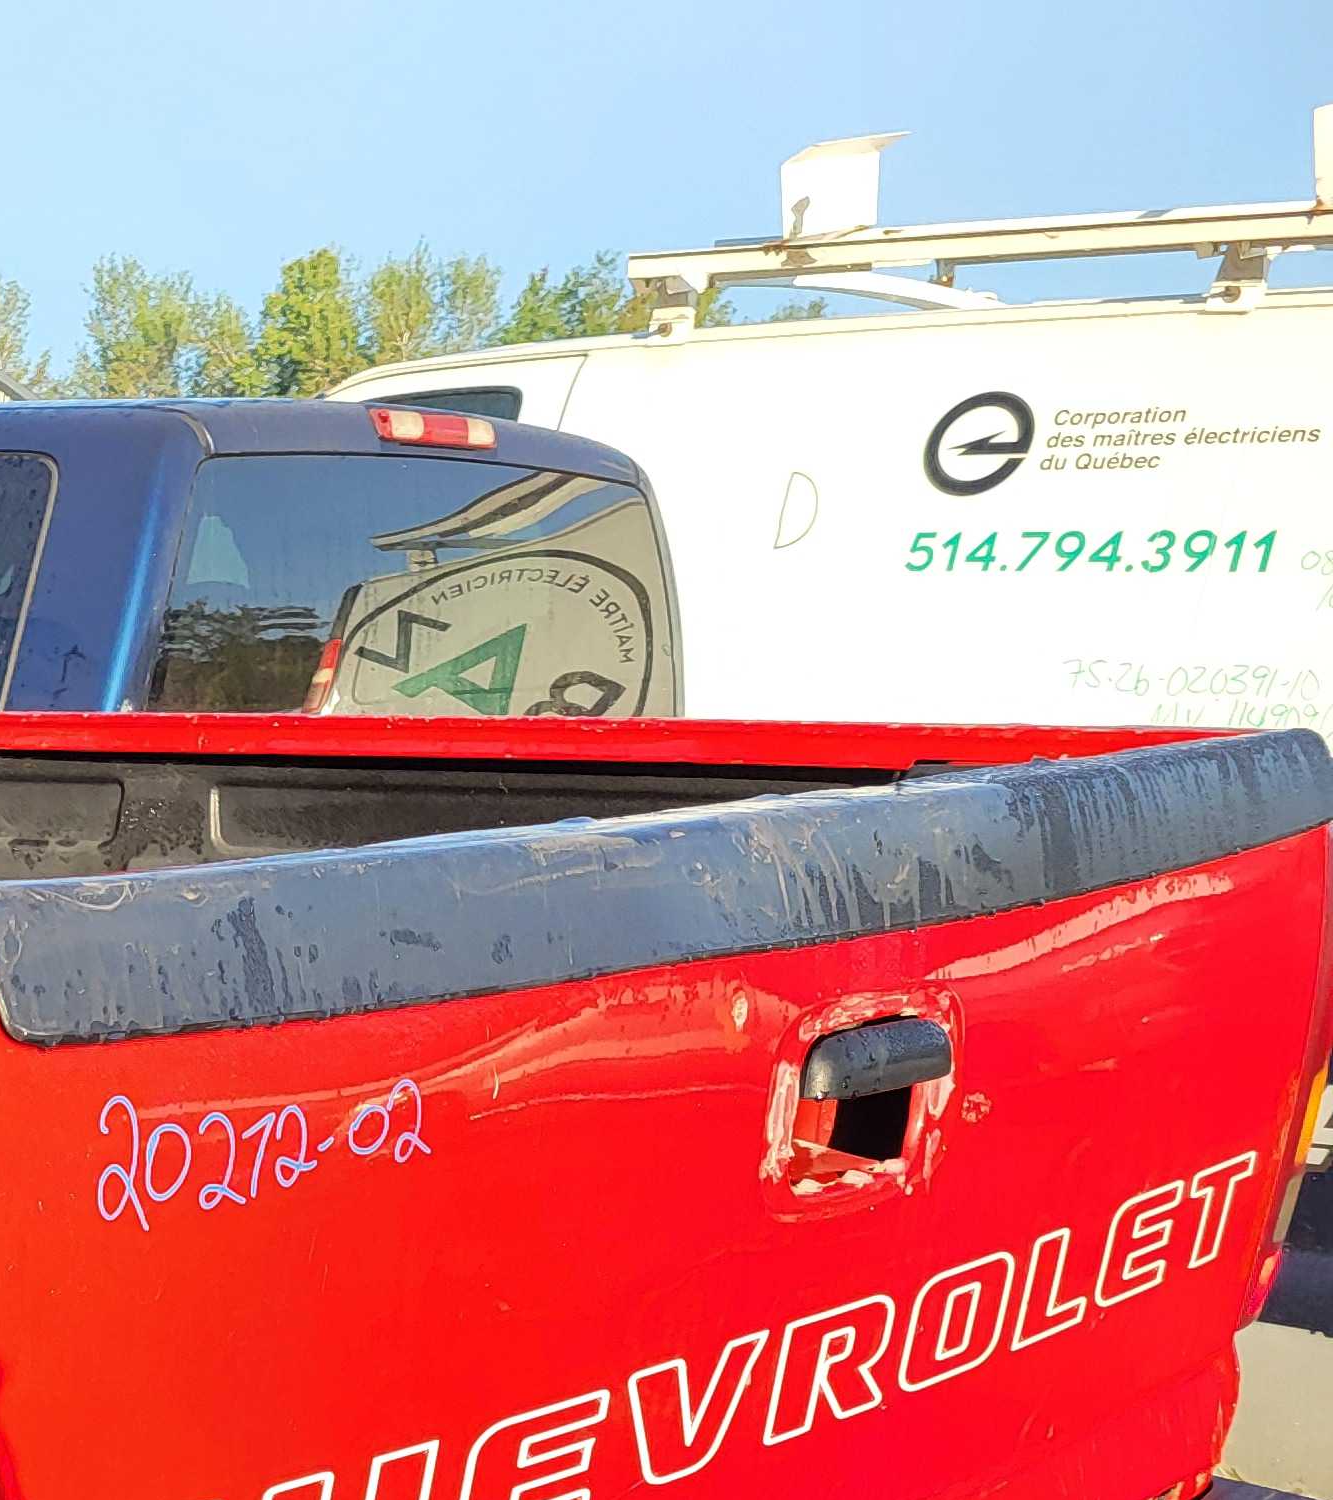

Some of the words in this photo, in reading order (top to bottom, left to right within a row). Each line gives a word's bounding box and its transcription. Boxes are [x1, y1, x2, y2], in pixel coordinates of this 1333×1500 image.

[1053, 406, 1187, 430] Corporation
[1045, 431, 1085, 449] des
[1092, 428, 1176, 448] maîtres
[1183, 424, 1321, 445] électriciens
[1039, 453, 1067, 471] du
[1074, 450, 1162, 471] Québec
[904, 528, 1278, 573] 514.794.3911
